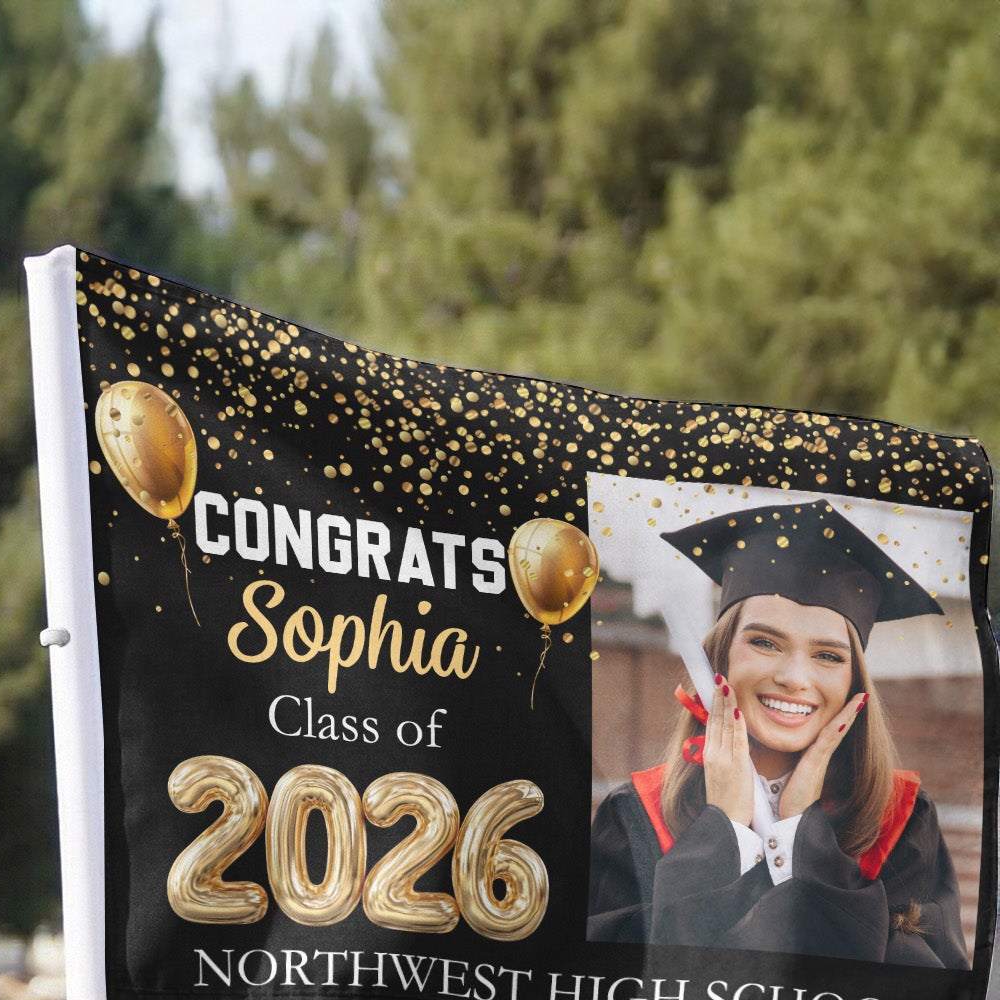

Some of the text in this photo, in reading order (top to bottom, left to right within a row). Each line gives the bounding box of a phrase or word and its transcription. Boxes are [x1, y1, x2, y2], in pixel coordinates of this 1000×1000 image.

[194, 490, 507, 595] CONGRATS
[226, 578, 481, 693] Sophia
[268, 694, 444, 749] Class of
[166, 754, 550, 942] 2026
